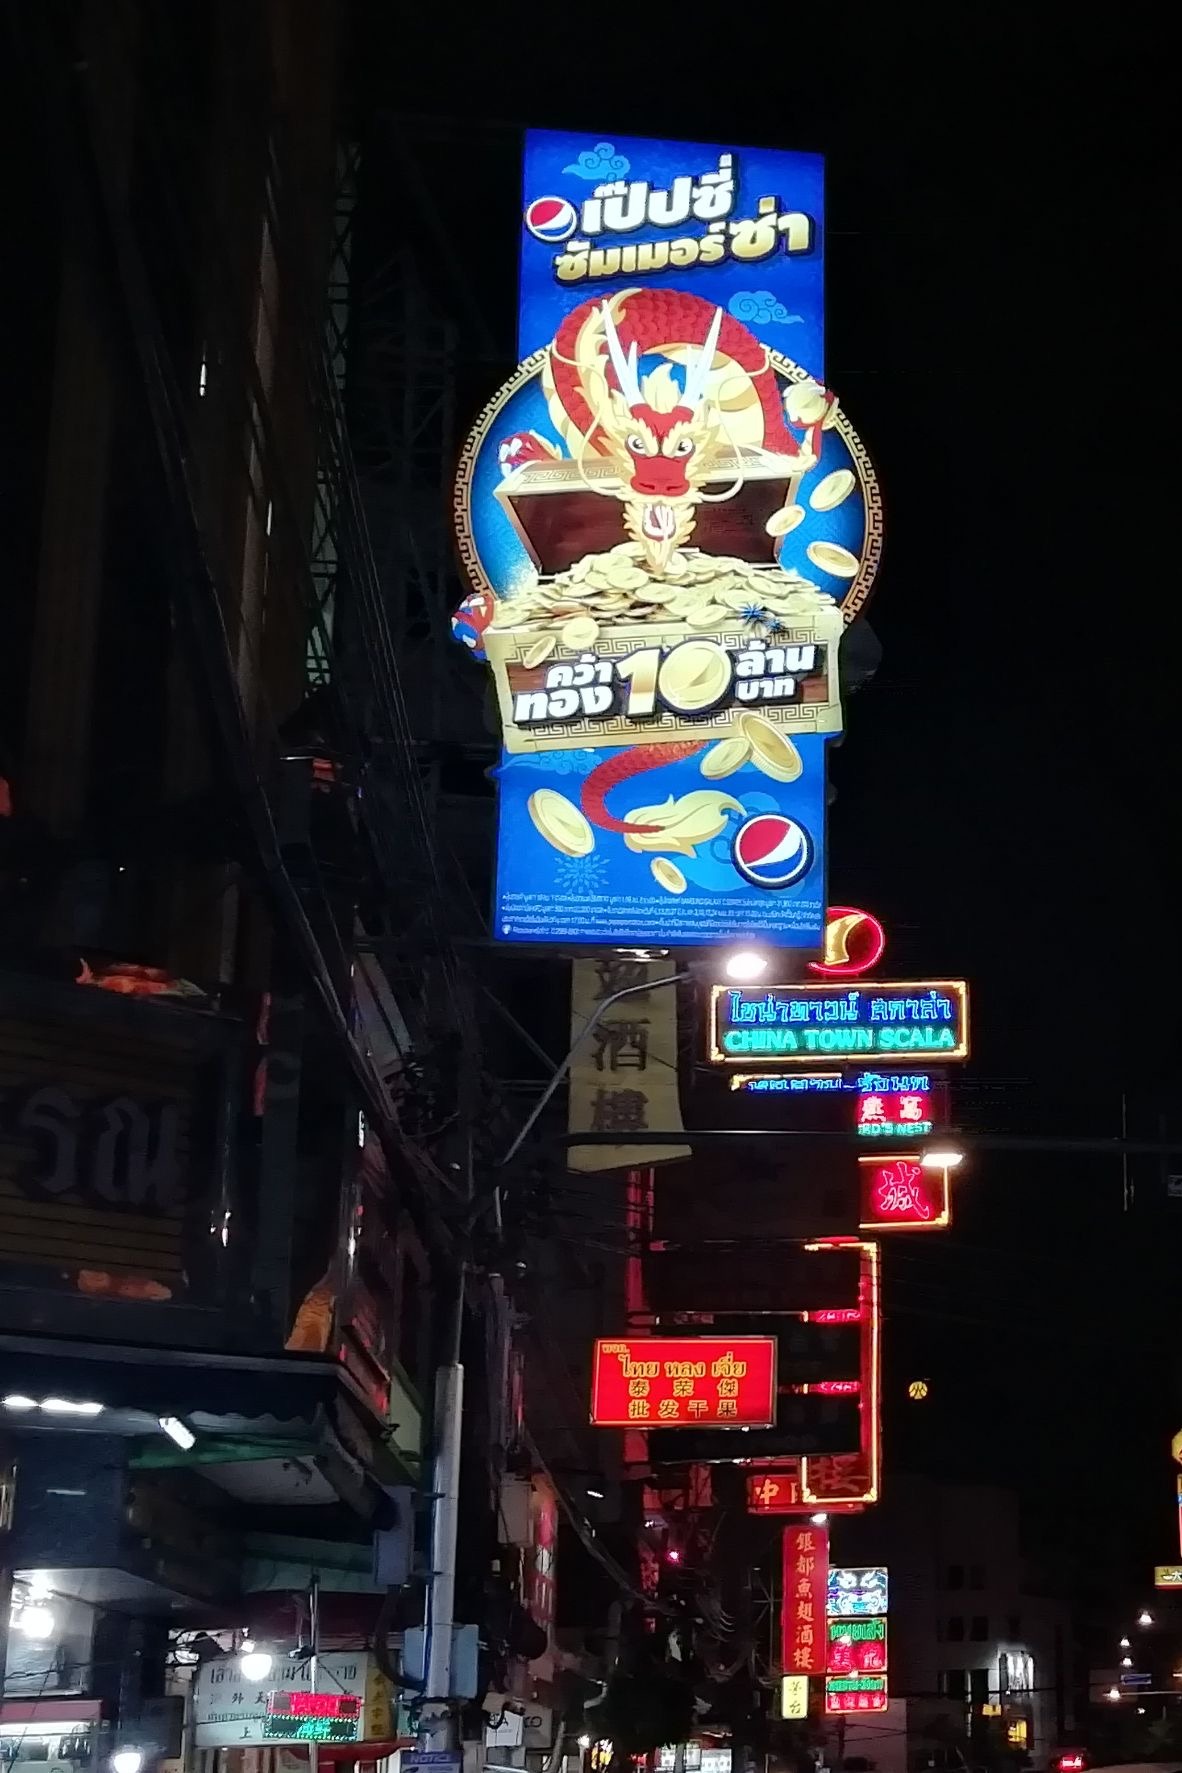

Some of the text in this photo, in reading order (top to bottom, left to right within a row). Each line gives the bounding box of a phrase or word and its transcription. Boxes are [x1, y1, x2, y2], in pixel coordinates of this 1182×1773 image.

[581, 153, 738, 237] เป๊ปซี่
[546, 654, 613, 690] คว้า
[736, 640, 816, 679] ล้าน
[513, 684, 613, 724] ทอง
[736, 676, 796, 702] บาท
[723, 1027, 955, 1051] CHINA TOWN SCALA
[618, 1354, 660, 1377] ไทย
